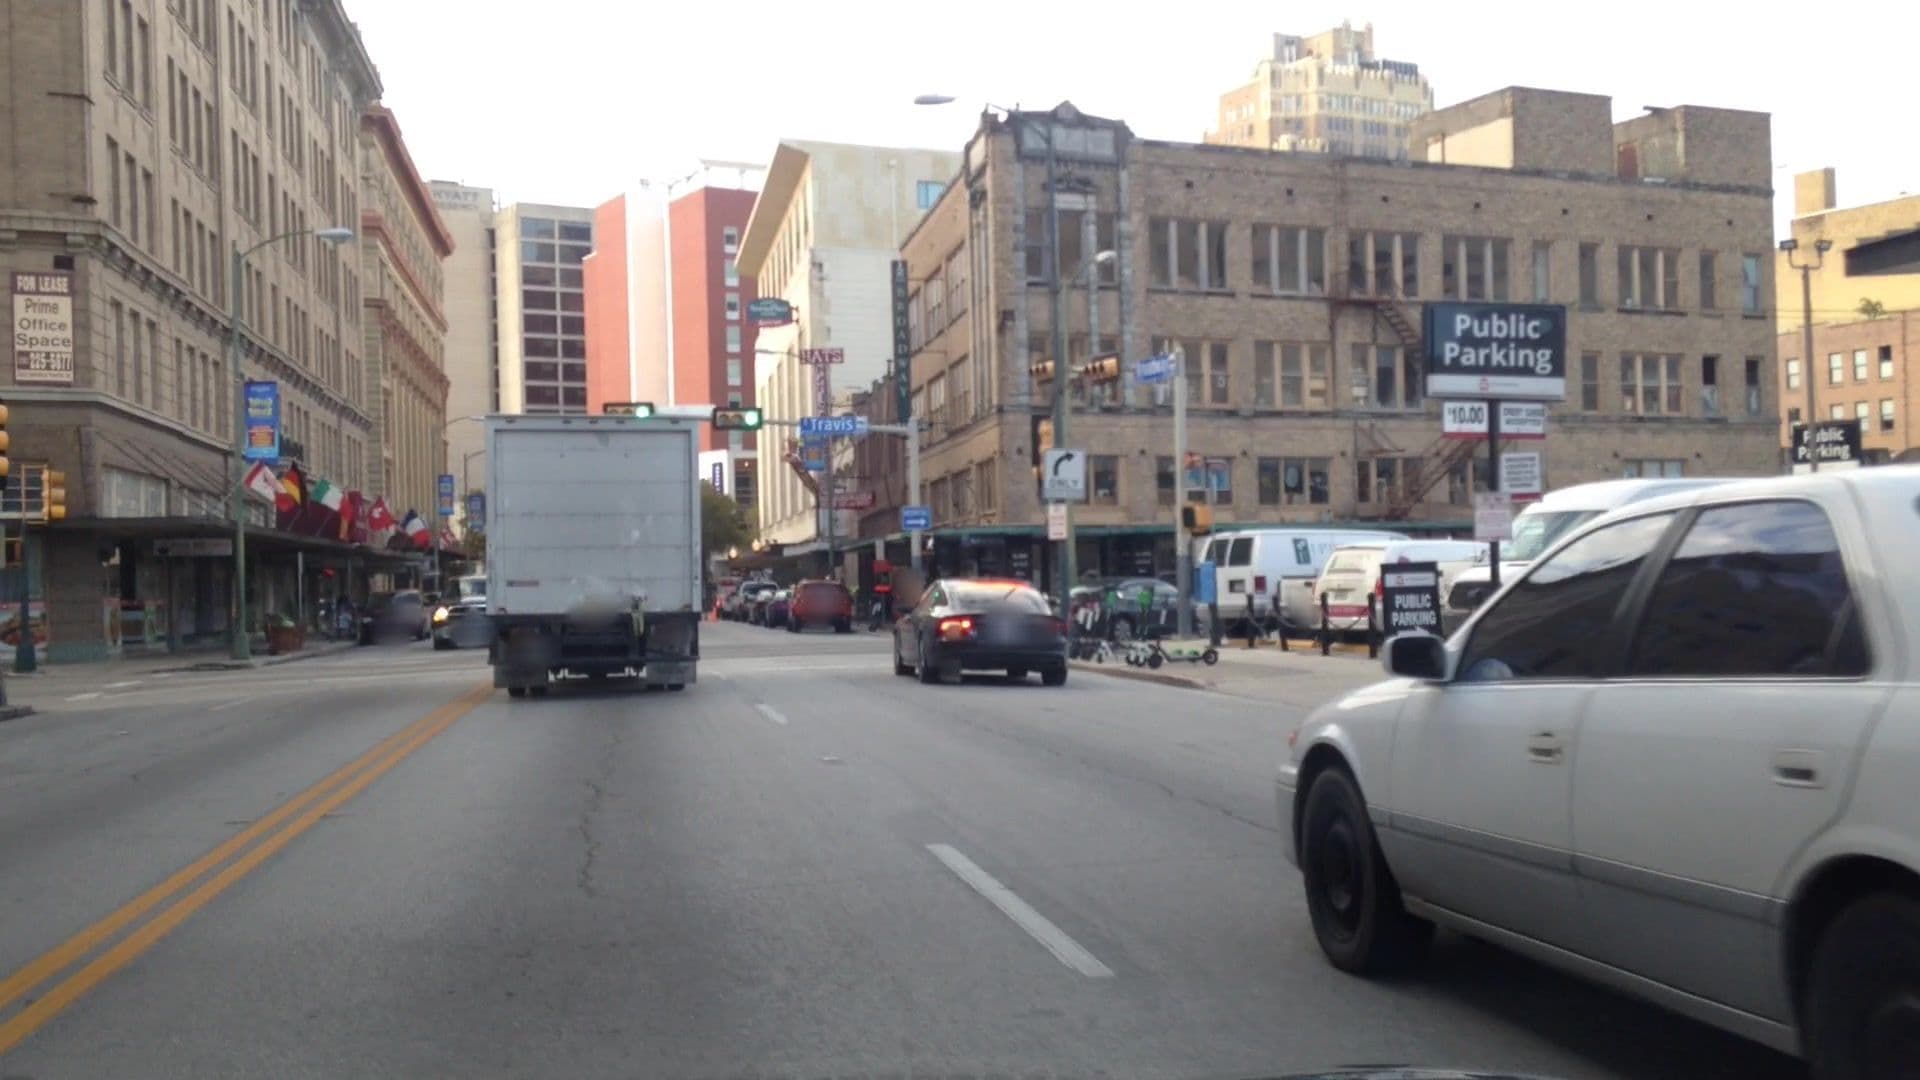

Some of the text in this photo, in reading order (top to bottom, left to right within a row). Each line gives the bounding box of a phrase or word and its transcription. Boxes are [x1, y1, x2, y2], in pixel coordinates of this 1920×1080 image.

[16, 274, 69, 294] FOR LEASE
[24, 297, 59, 315] Prime
[18, 317, 68, 333] Office
[1454, 312, 1541, 339] Public
[15, 332, 71, 349] Space
[801, 350, 841, 363] HATS
[1442, 341, 1553, 375] Parking
[810, 418, 854, 432] Travis
[1048, 479, 1079, 490] ONLY
[1394, 594, 1432, 609] PUBLIC
[1391, 611, 1437, 626] PARKING
